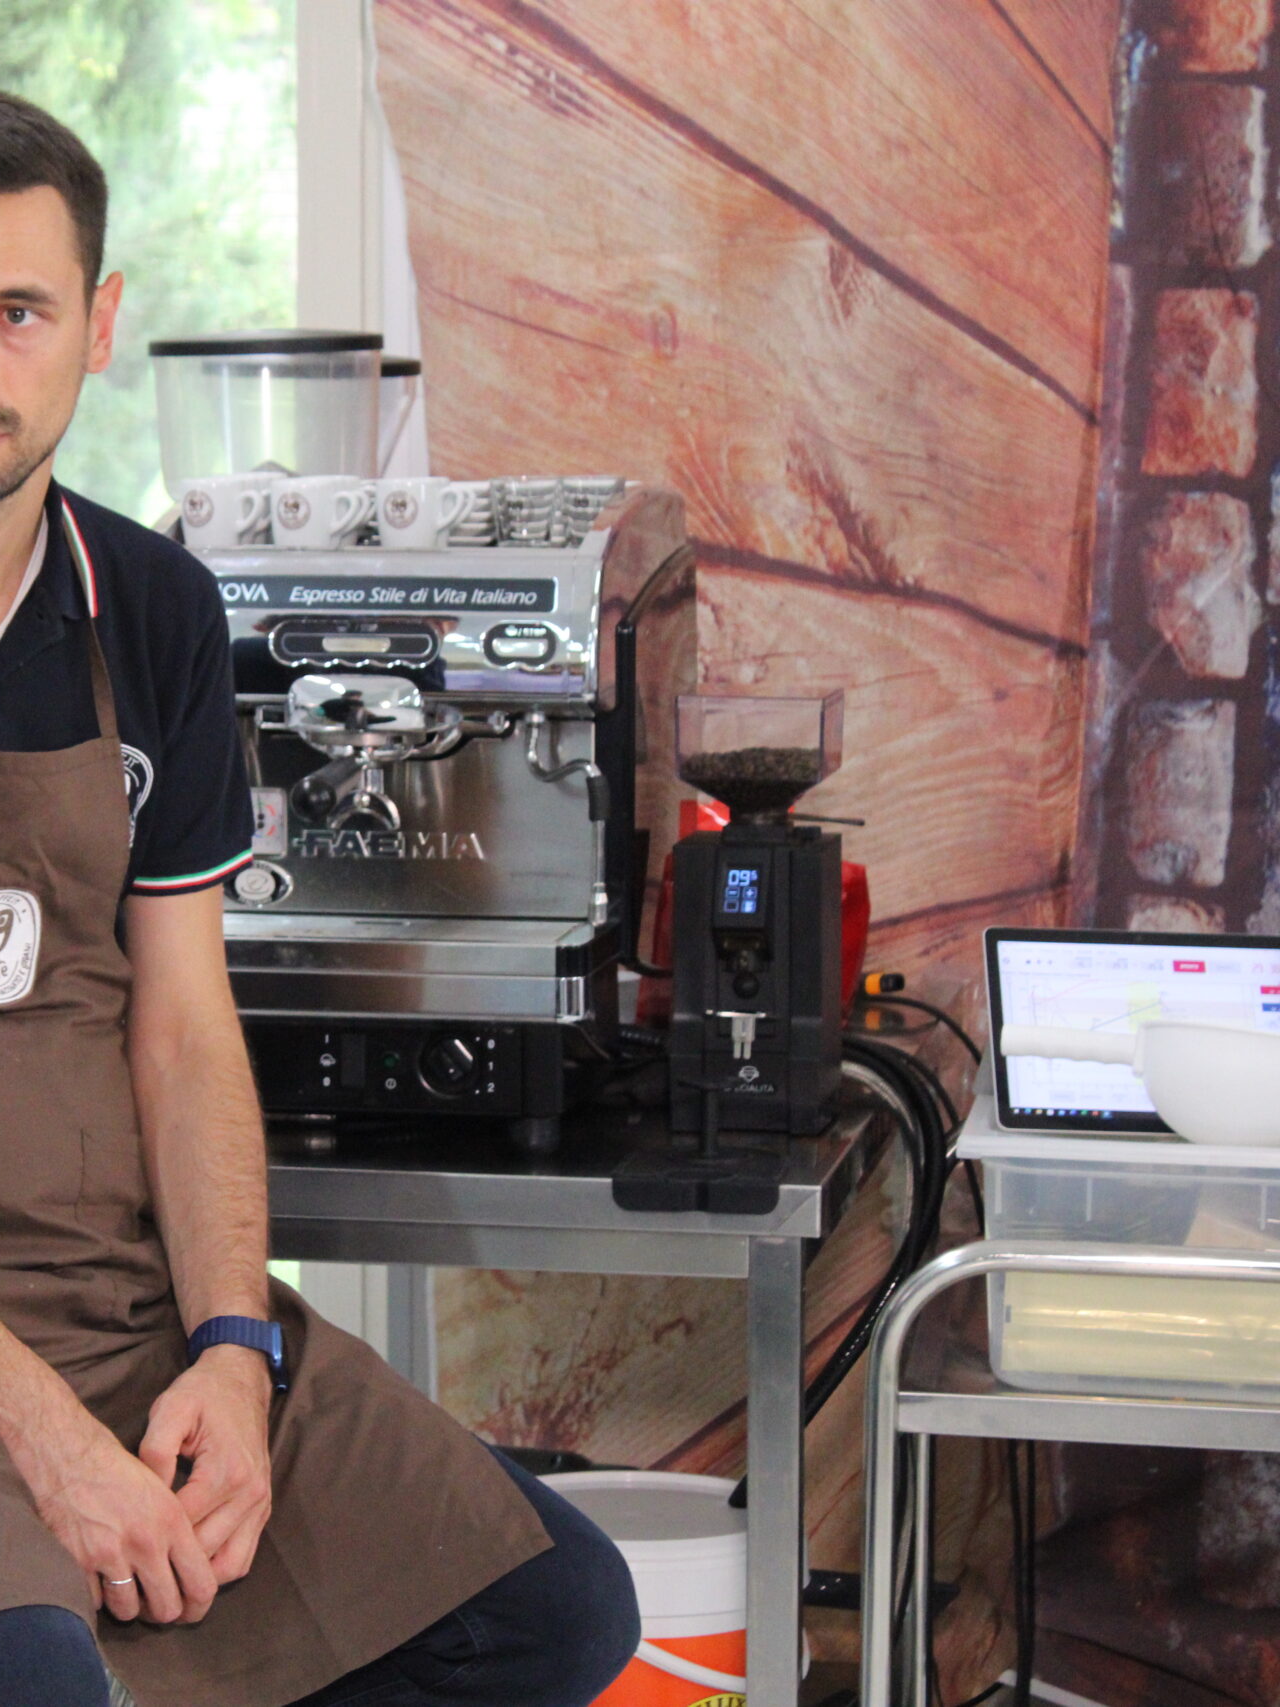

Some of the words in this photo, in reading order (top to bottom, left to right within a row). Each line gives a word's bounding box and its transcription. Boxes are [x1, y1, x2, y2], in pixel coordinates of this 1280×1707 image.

[289, 587, 364, 605] Espresso
[369, 587, 406, 603] Stile
[410, 587, 428, 602] di
[433, 588, 467, 604] Vita
[471, 589, 537, 605] Italiano
[292, 829, 485, 860] FAEMA
